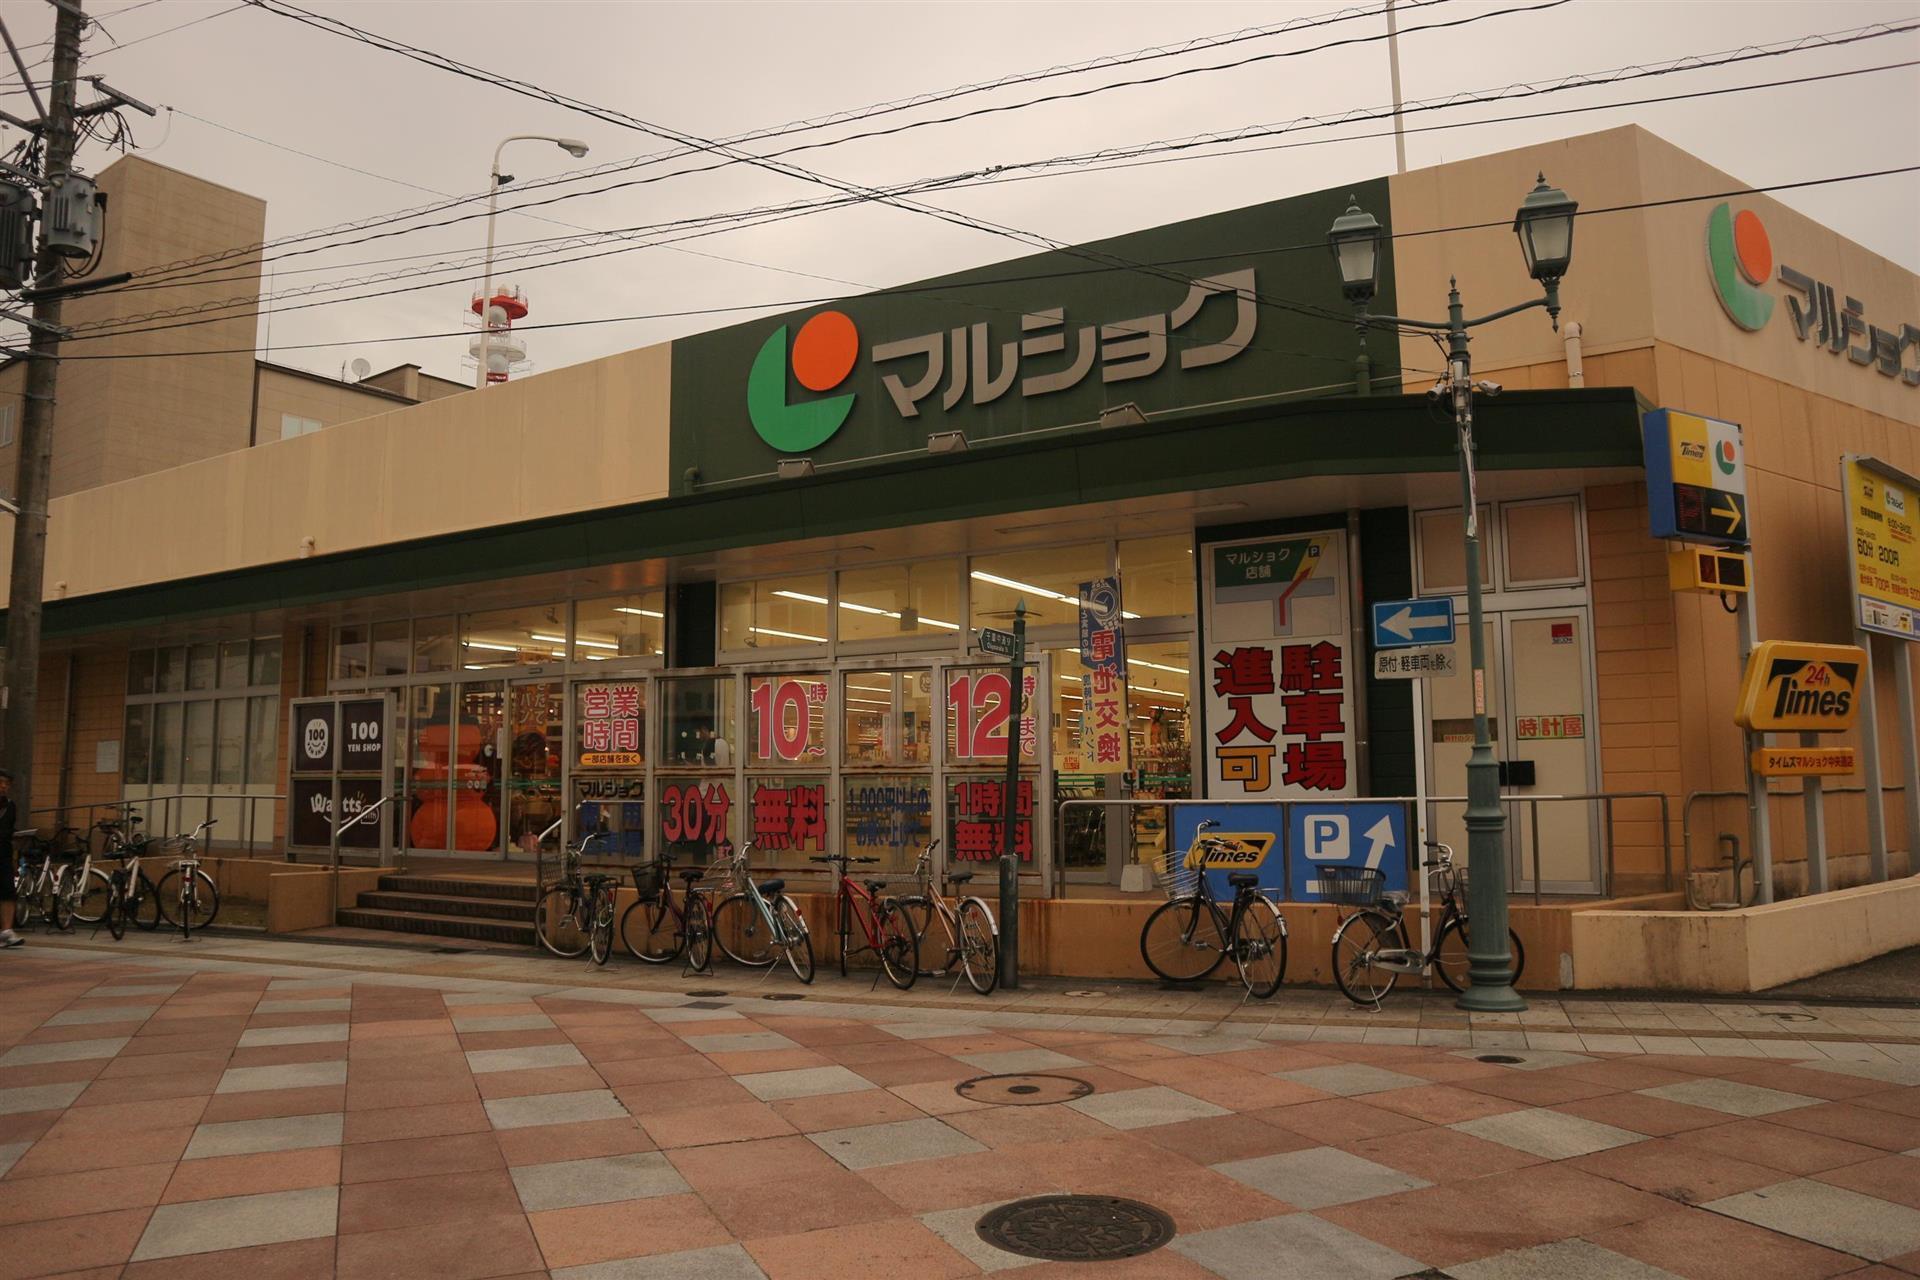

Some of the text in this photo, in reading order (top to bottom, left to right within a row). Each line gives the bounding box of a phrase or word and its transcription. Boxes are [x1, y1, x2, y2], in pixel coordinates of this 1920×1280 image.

[872, 268, 1256, 416] マルショク
[1225, 547, 1290, 565] マルショク
[1246, 564, 1272, 580] 店舗
[585, 686, 640, 718] 営業
[1773, 676, 1852, 718] Times
[351, 721, 379, 740] 100
[1213, 647, 1278, 792] 進入可
[1280, 640, 1346, 791] 駐車場
[1518, 717, 1581, 737] 時計屋
[308, 729, 325, 741] 100
[348, 743, 382, 753] YEN SHOP
[584, 719, 639, 751] 時間
[753, 784, 827, 851] 無料
[1314, 820, 1340, 853] P
